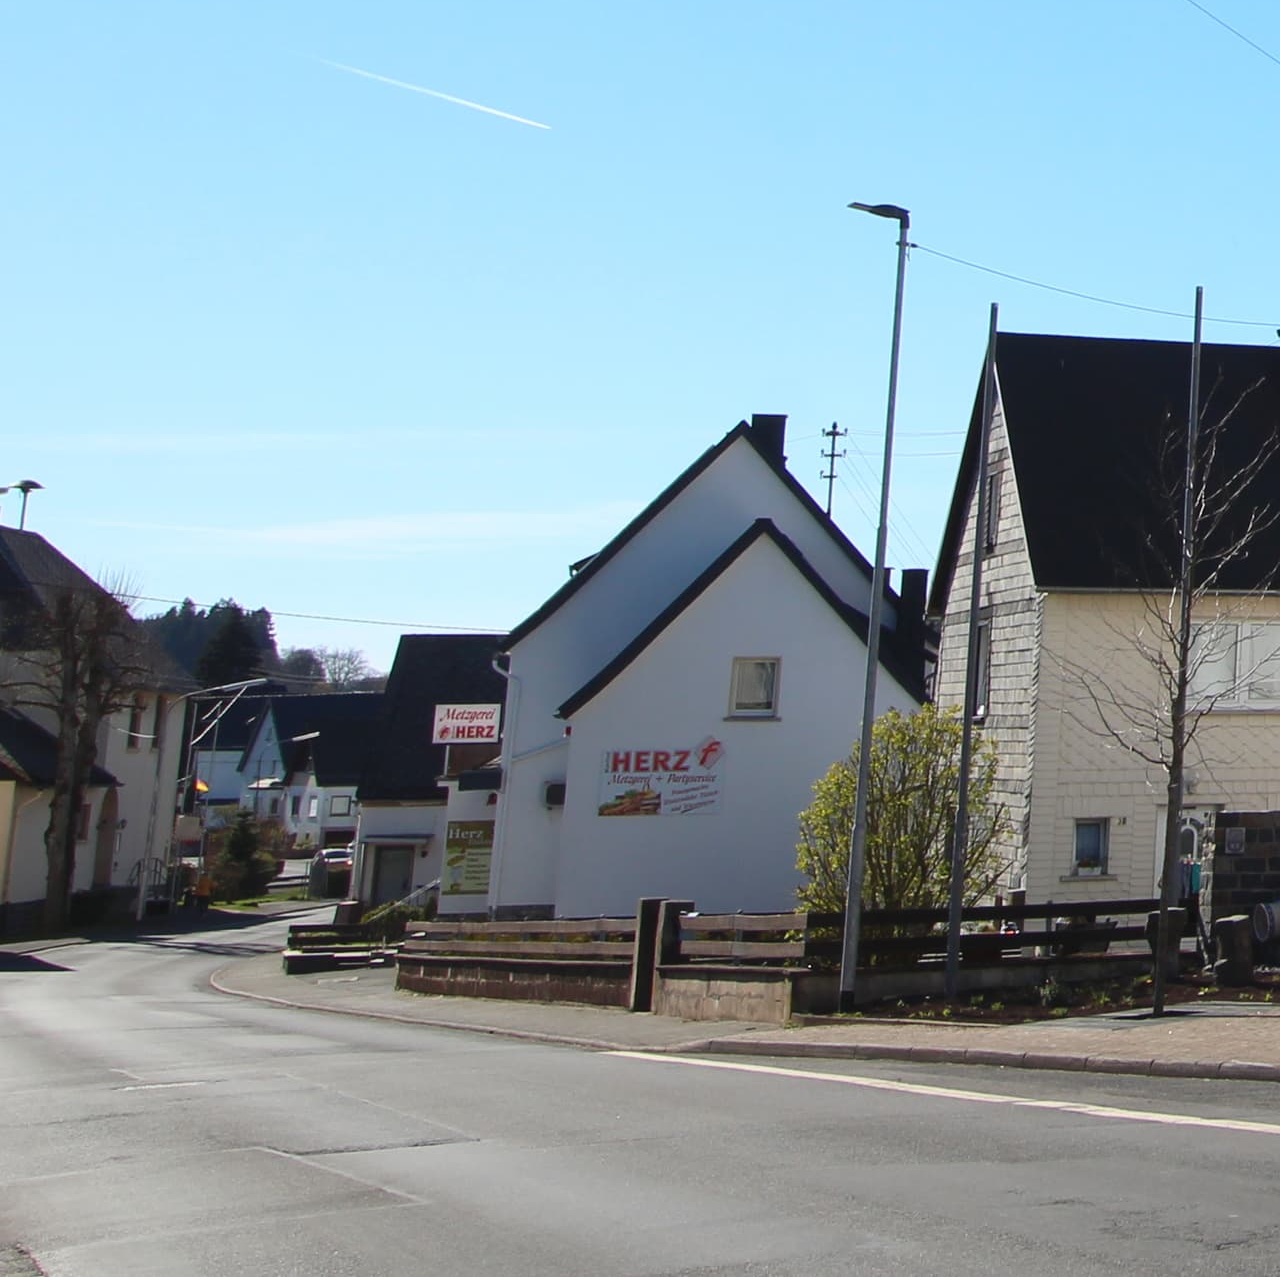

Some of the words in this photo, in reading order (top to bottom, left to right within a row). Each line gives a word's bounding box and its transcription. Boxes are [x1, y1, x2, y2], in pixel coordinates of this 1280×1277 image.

[440, 708, 495, 723] Metzgerei
[456, 726, 495, 738] HERZ
[612, 751, 690, 771] HERZ
[449, 829, 483, 839] Herz
